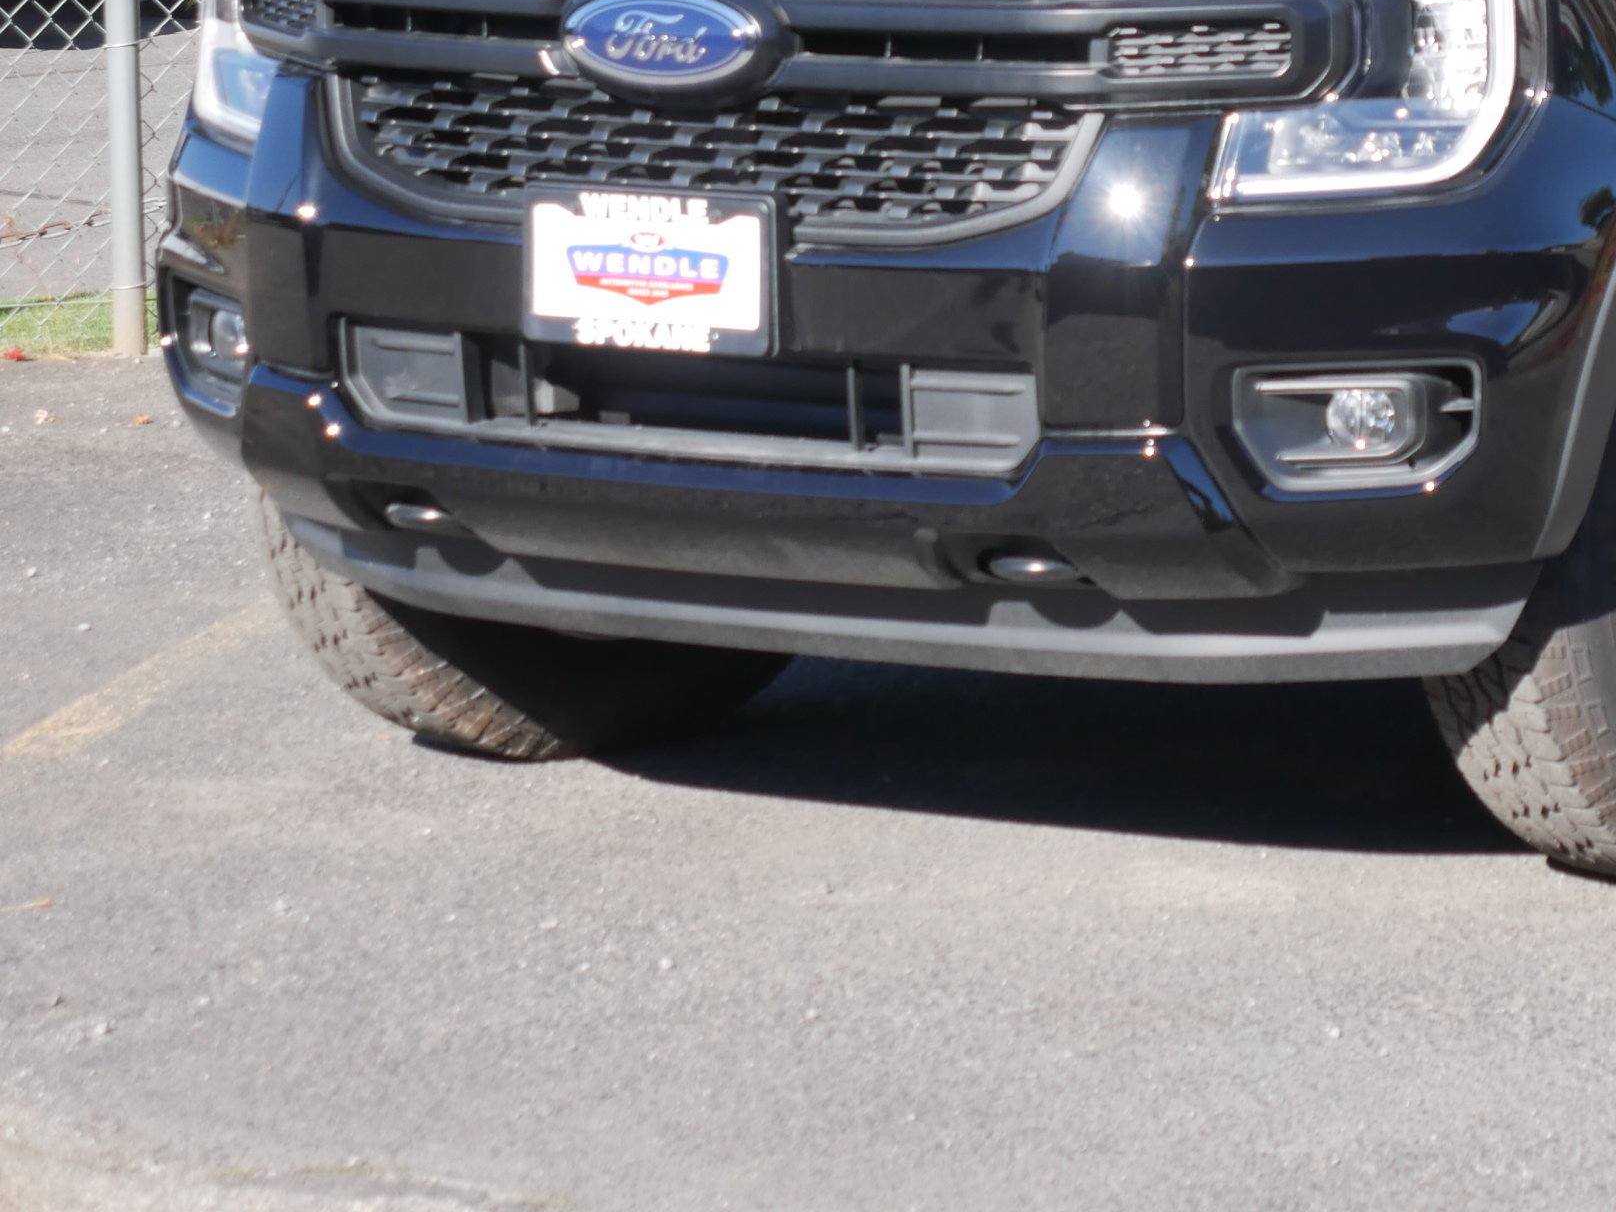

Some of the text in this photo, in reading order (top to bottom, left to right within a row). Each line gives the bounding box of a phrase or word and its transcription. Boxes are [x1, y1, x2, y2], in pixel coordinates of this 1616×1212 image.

[606, 9, 708, 64] Ford
[580, 192, 709, 223] WENDLE
[573, 251, 719, 278] WENDLE
